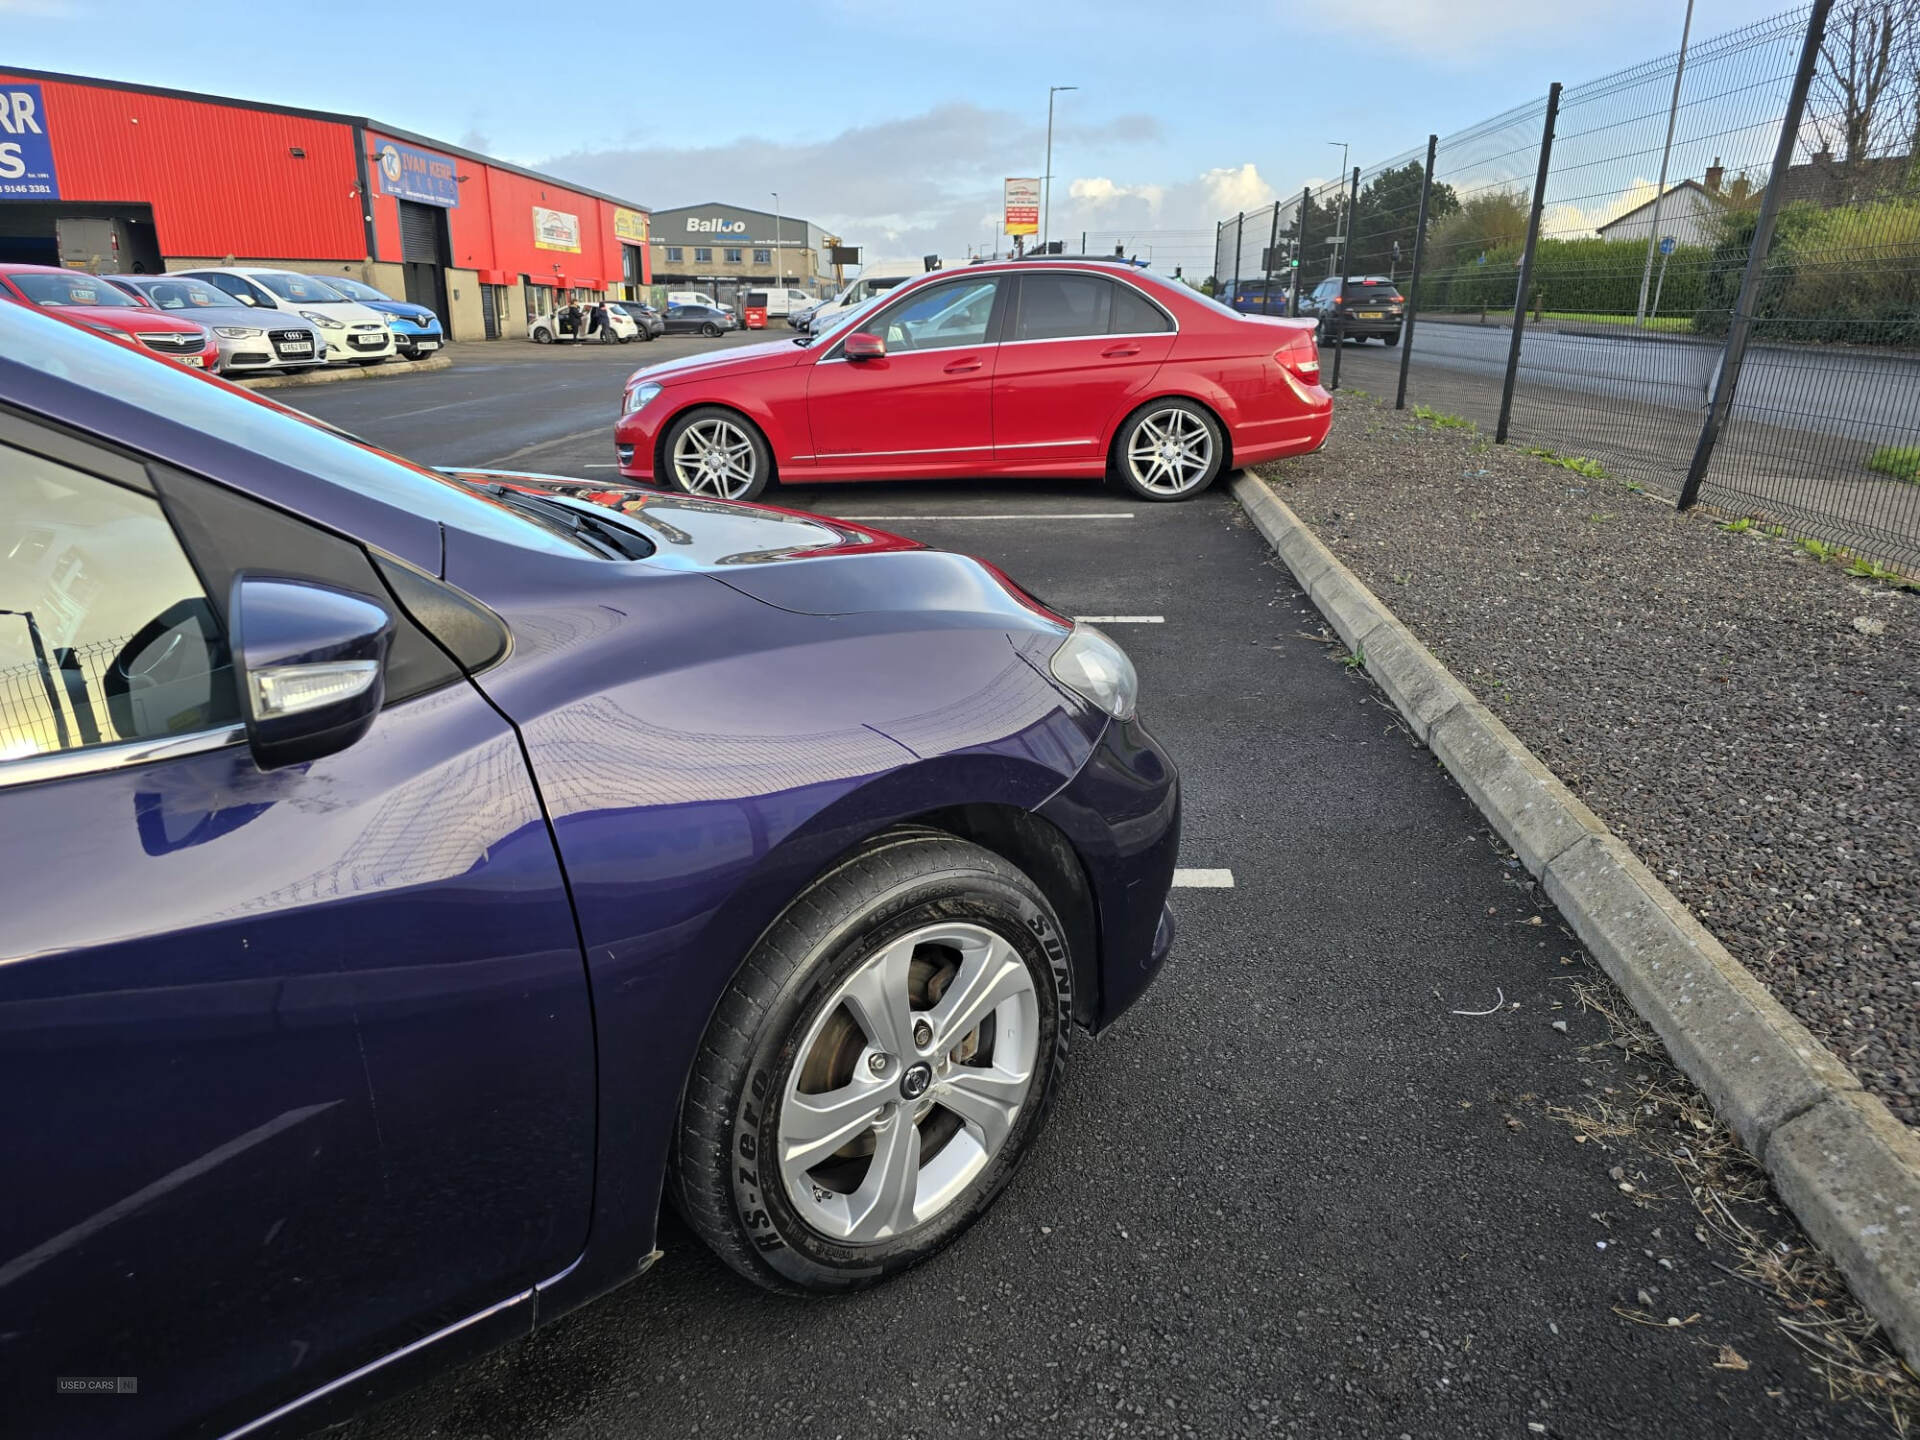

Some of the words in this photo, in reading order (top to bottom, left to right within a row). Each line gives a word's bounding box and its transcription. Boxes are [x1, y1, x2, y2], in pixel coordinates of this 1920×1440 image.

[0, 142, 25, 179] S
[4, 185, 27, 193] 9146
[29, 184, 51, 193] 3381
[686, 217, 746, 233] Balloo
